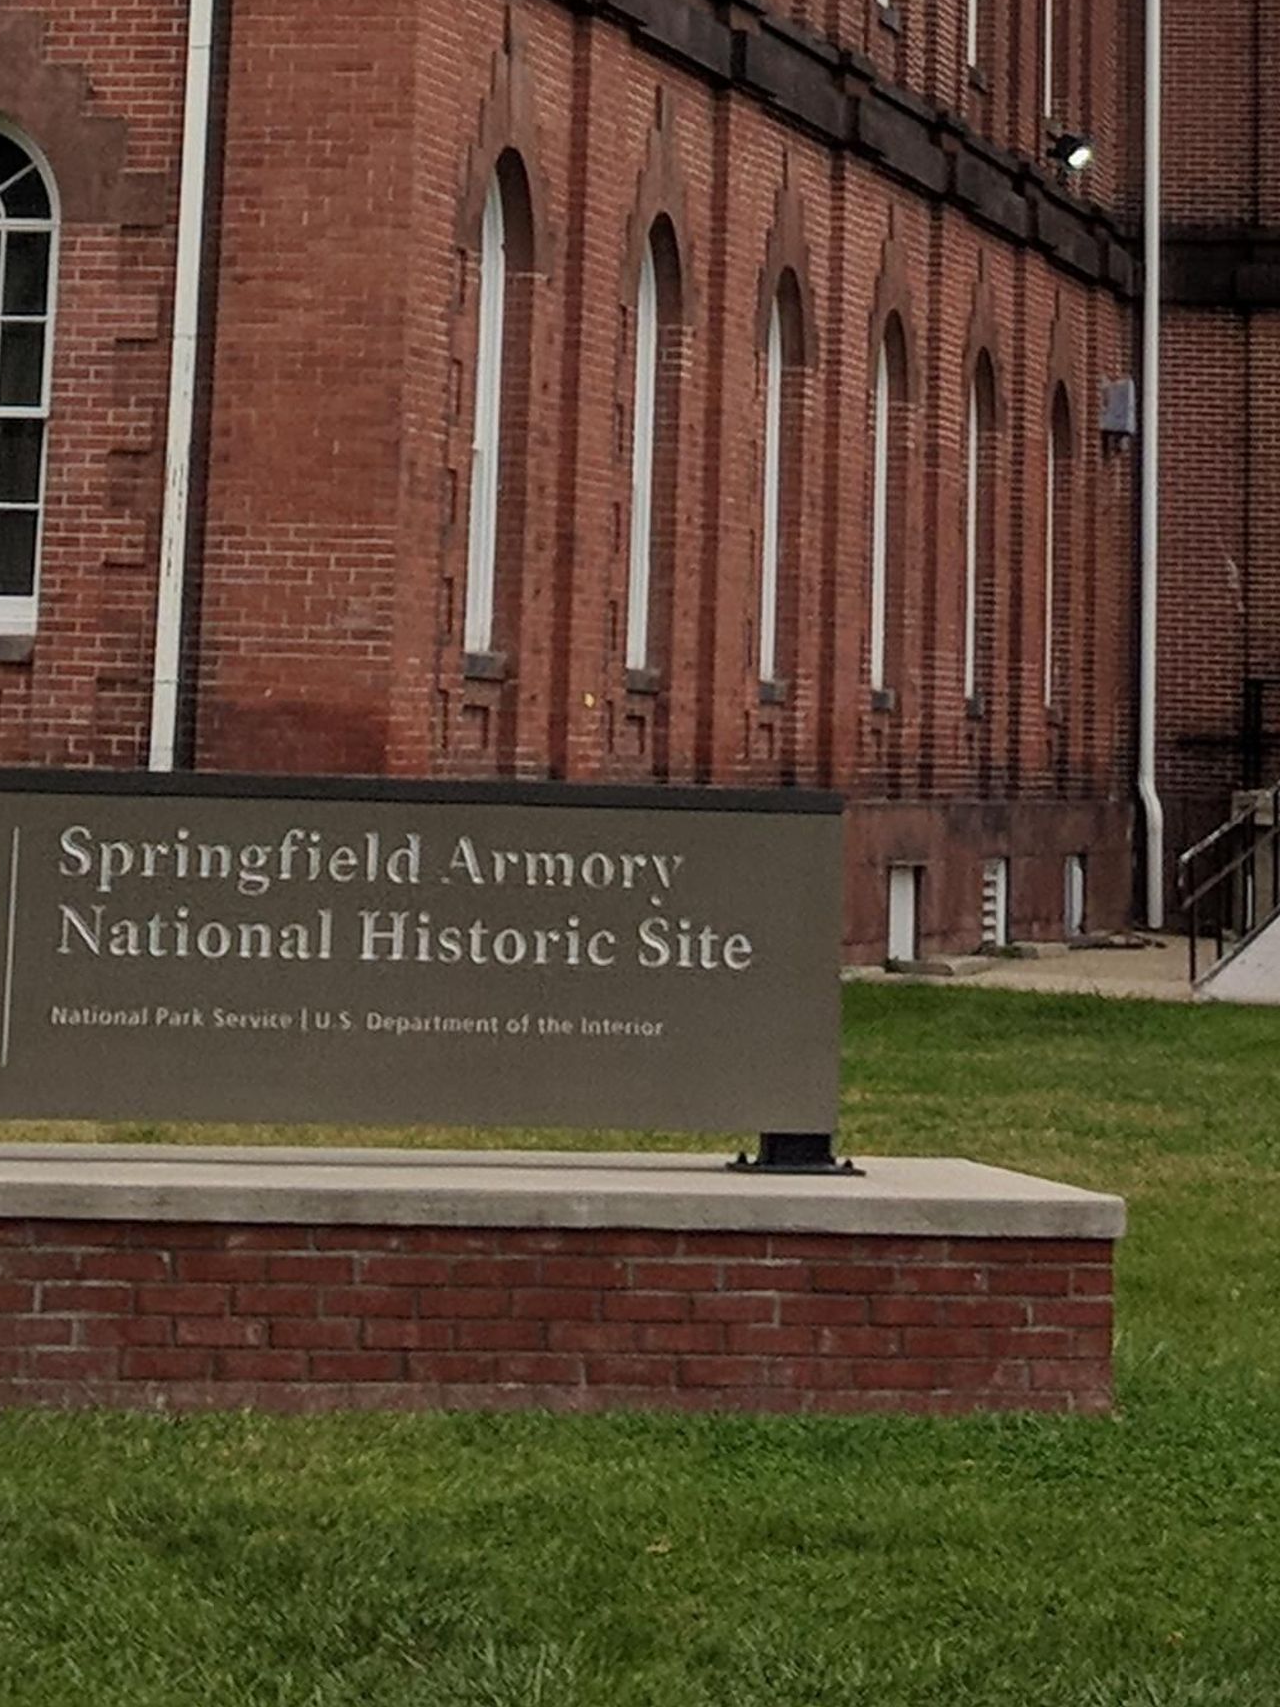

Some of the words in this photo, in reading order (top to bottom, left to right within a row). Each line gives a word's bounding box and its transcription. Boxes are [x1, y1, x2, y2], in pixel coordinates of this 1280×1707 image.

[58, 824, 421, 895] Springfield
[440, 835, 685, 907] Armory
[56, 904, 334, 960] National
[358, 909, 616, 967] Historic
[636, 916, 754, 970] Site
[50, 1005, 148, 1026] National
[154, 1007, 205, 1028] Park
[213, 1008, 294, 1031] Service
[366, 1012, 499, 1035] Department
[505, 1014, 529, 1034] of
[537, 1017, 573, 1035] the
[580, 1016, 665, 1037] Interior
